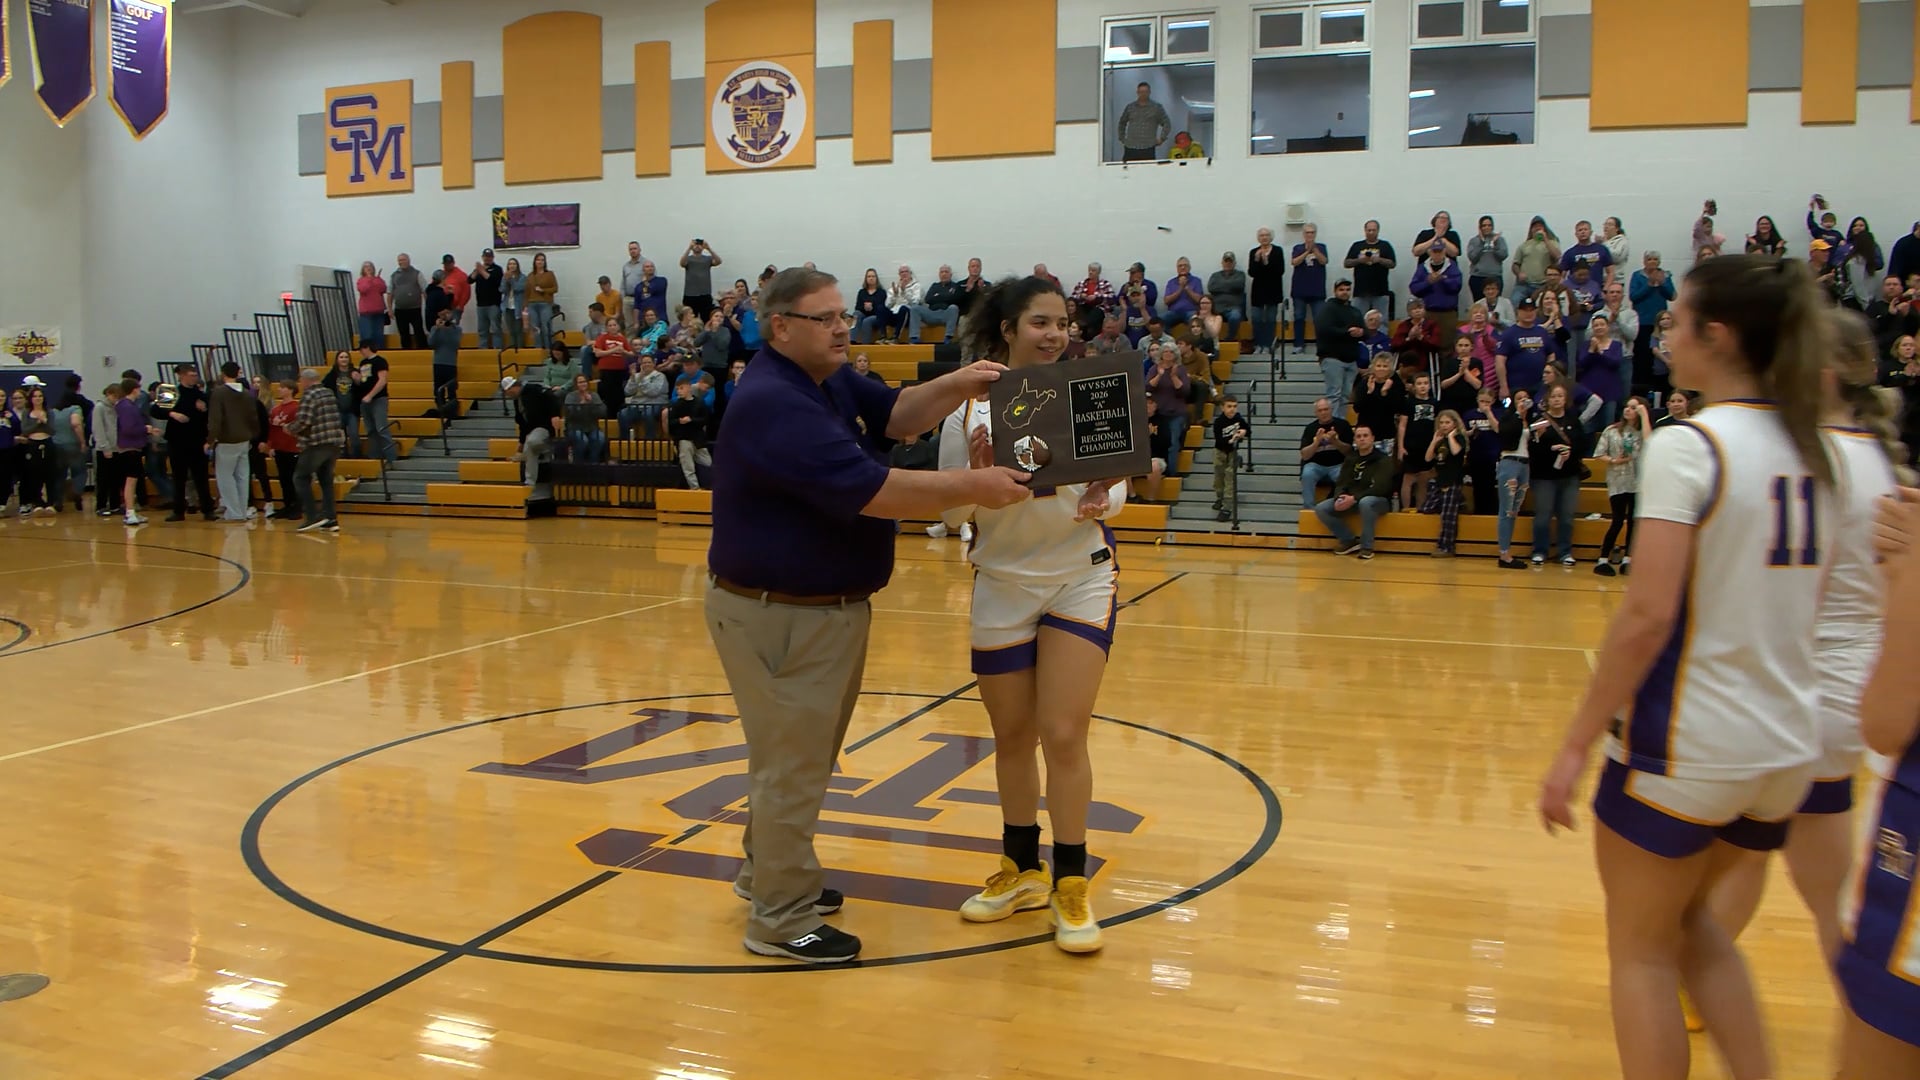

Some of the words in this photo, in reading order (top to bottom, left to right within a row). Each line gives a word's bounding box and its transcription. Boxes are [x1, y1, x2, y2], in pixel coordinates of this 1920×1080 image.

[127, 4, 153, 20] GOLF
[330, 95, 405, 183] SM
[1078, 379, 1118, 390] WVSSAC
[1090, 391, 1109, 400] 2026
[1094, 400, 1105, 408] "A"
[1075, 408, 1126, 423] BASKETBALL
[1081, 430, 1124, 444] REGIONAL
[1080, 440, 1126, 453] CHAMPION
[1766, 474, 1817, 568] 11
